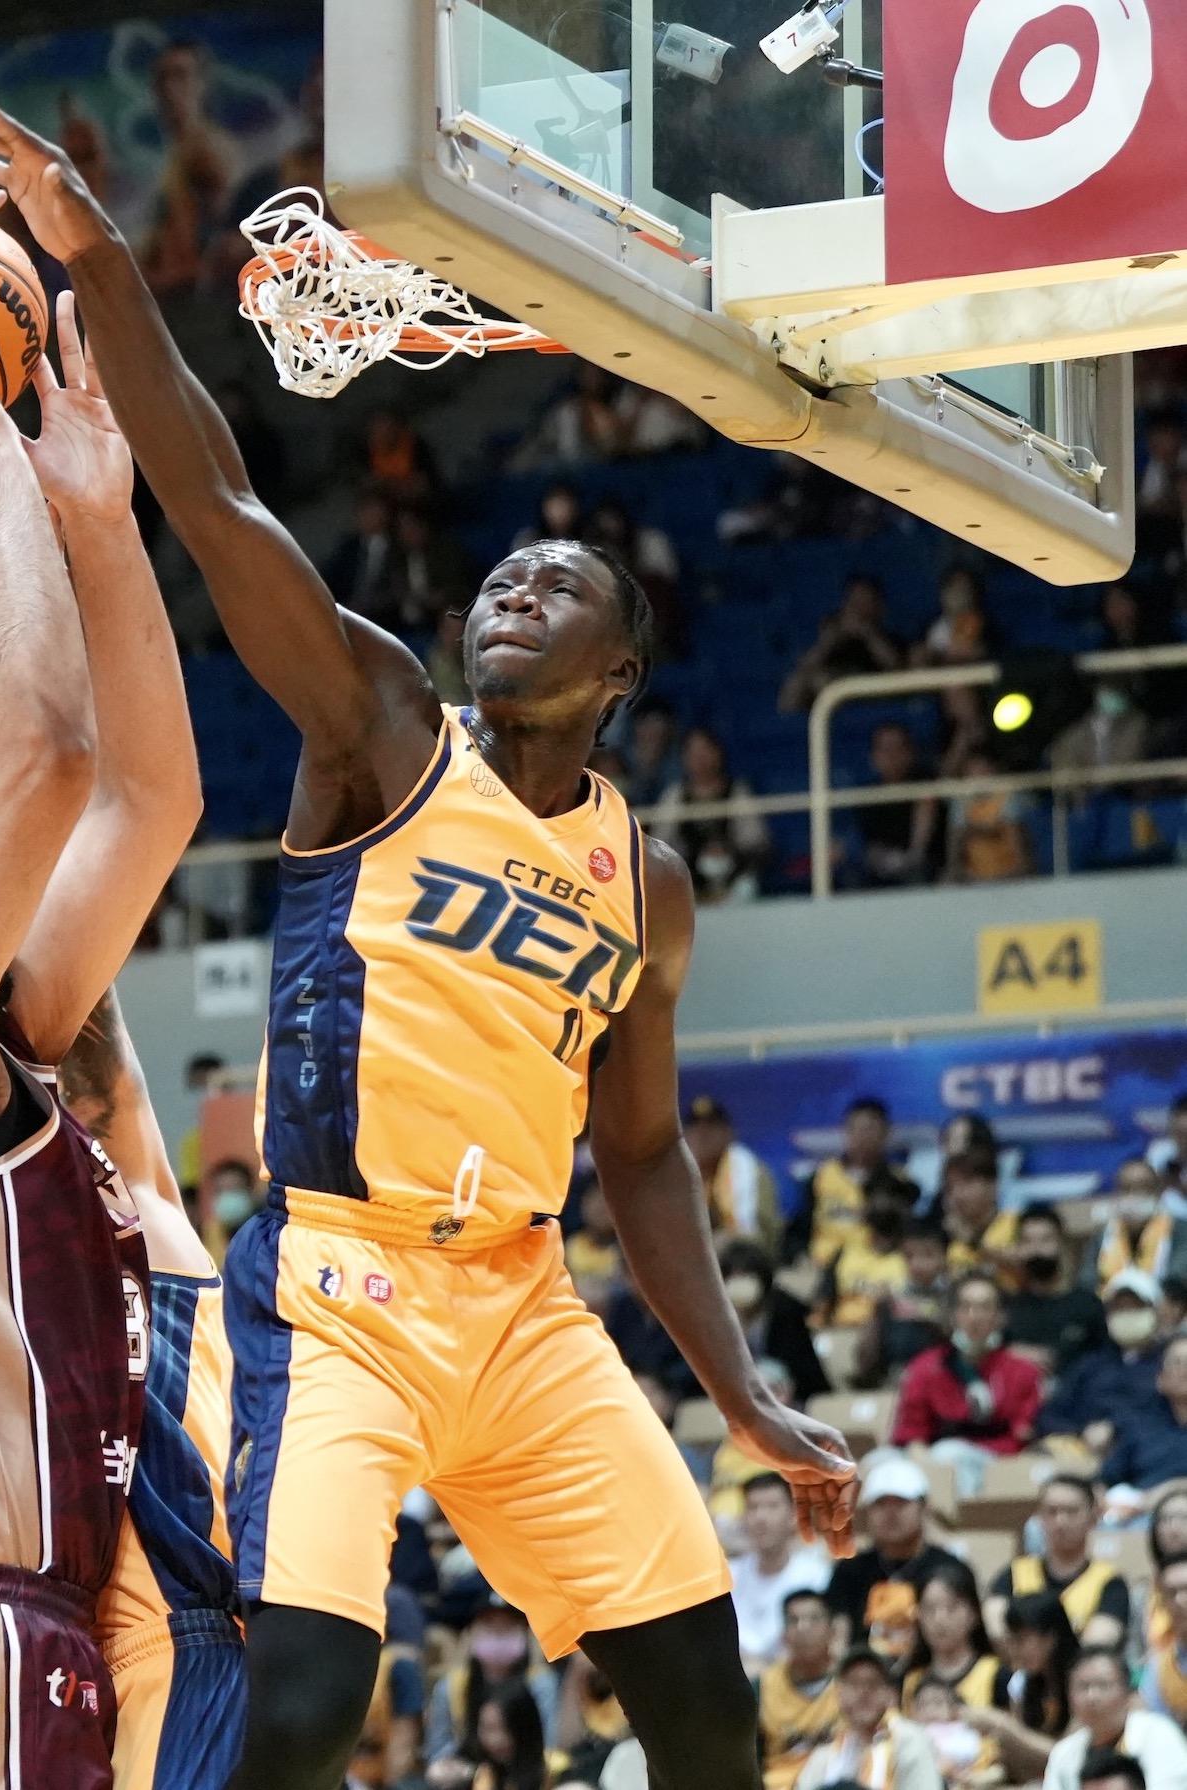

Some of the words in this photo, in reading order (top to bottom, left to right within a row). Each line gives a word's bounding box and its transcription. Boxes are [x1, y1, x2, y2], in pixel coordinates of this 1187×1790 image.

[786, 32, 798, 47] 7
[503, 858, 595, 911] CTBC
[988, 935, 1087, 991] A4
[942, 1055, 1103, 1109] CTBC
